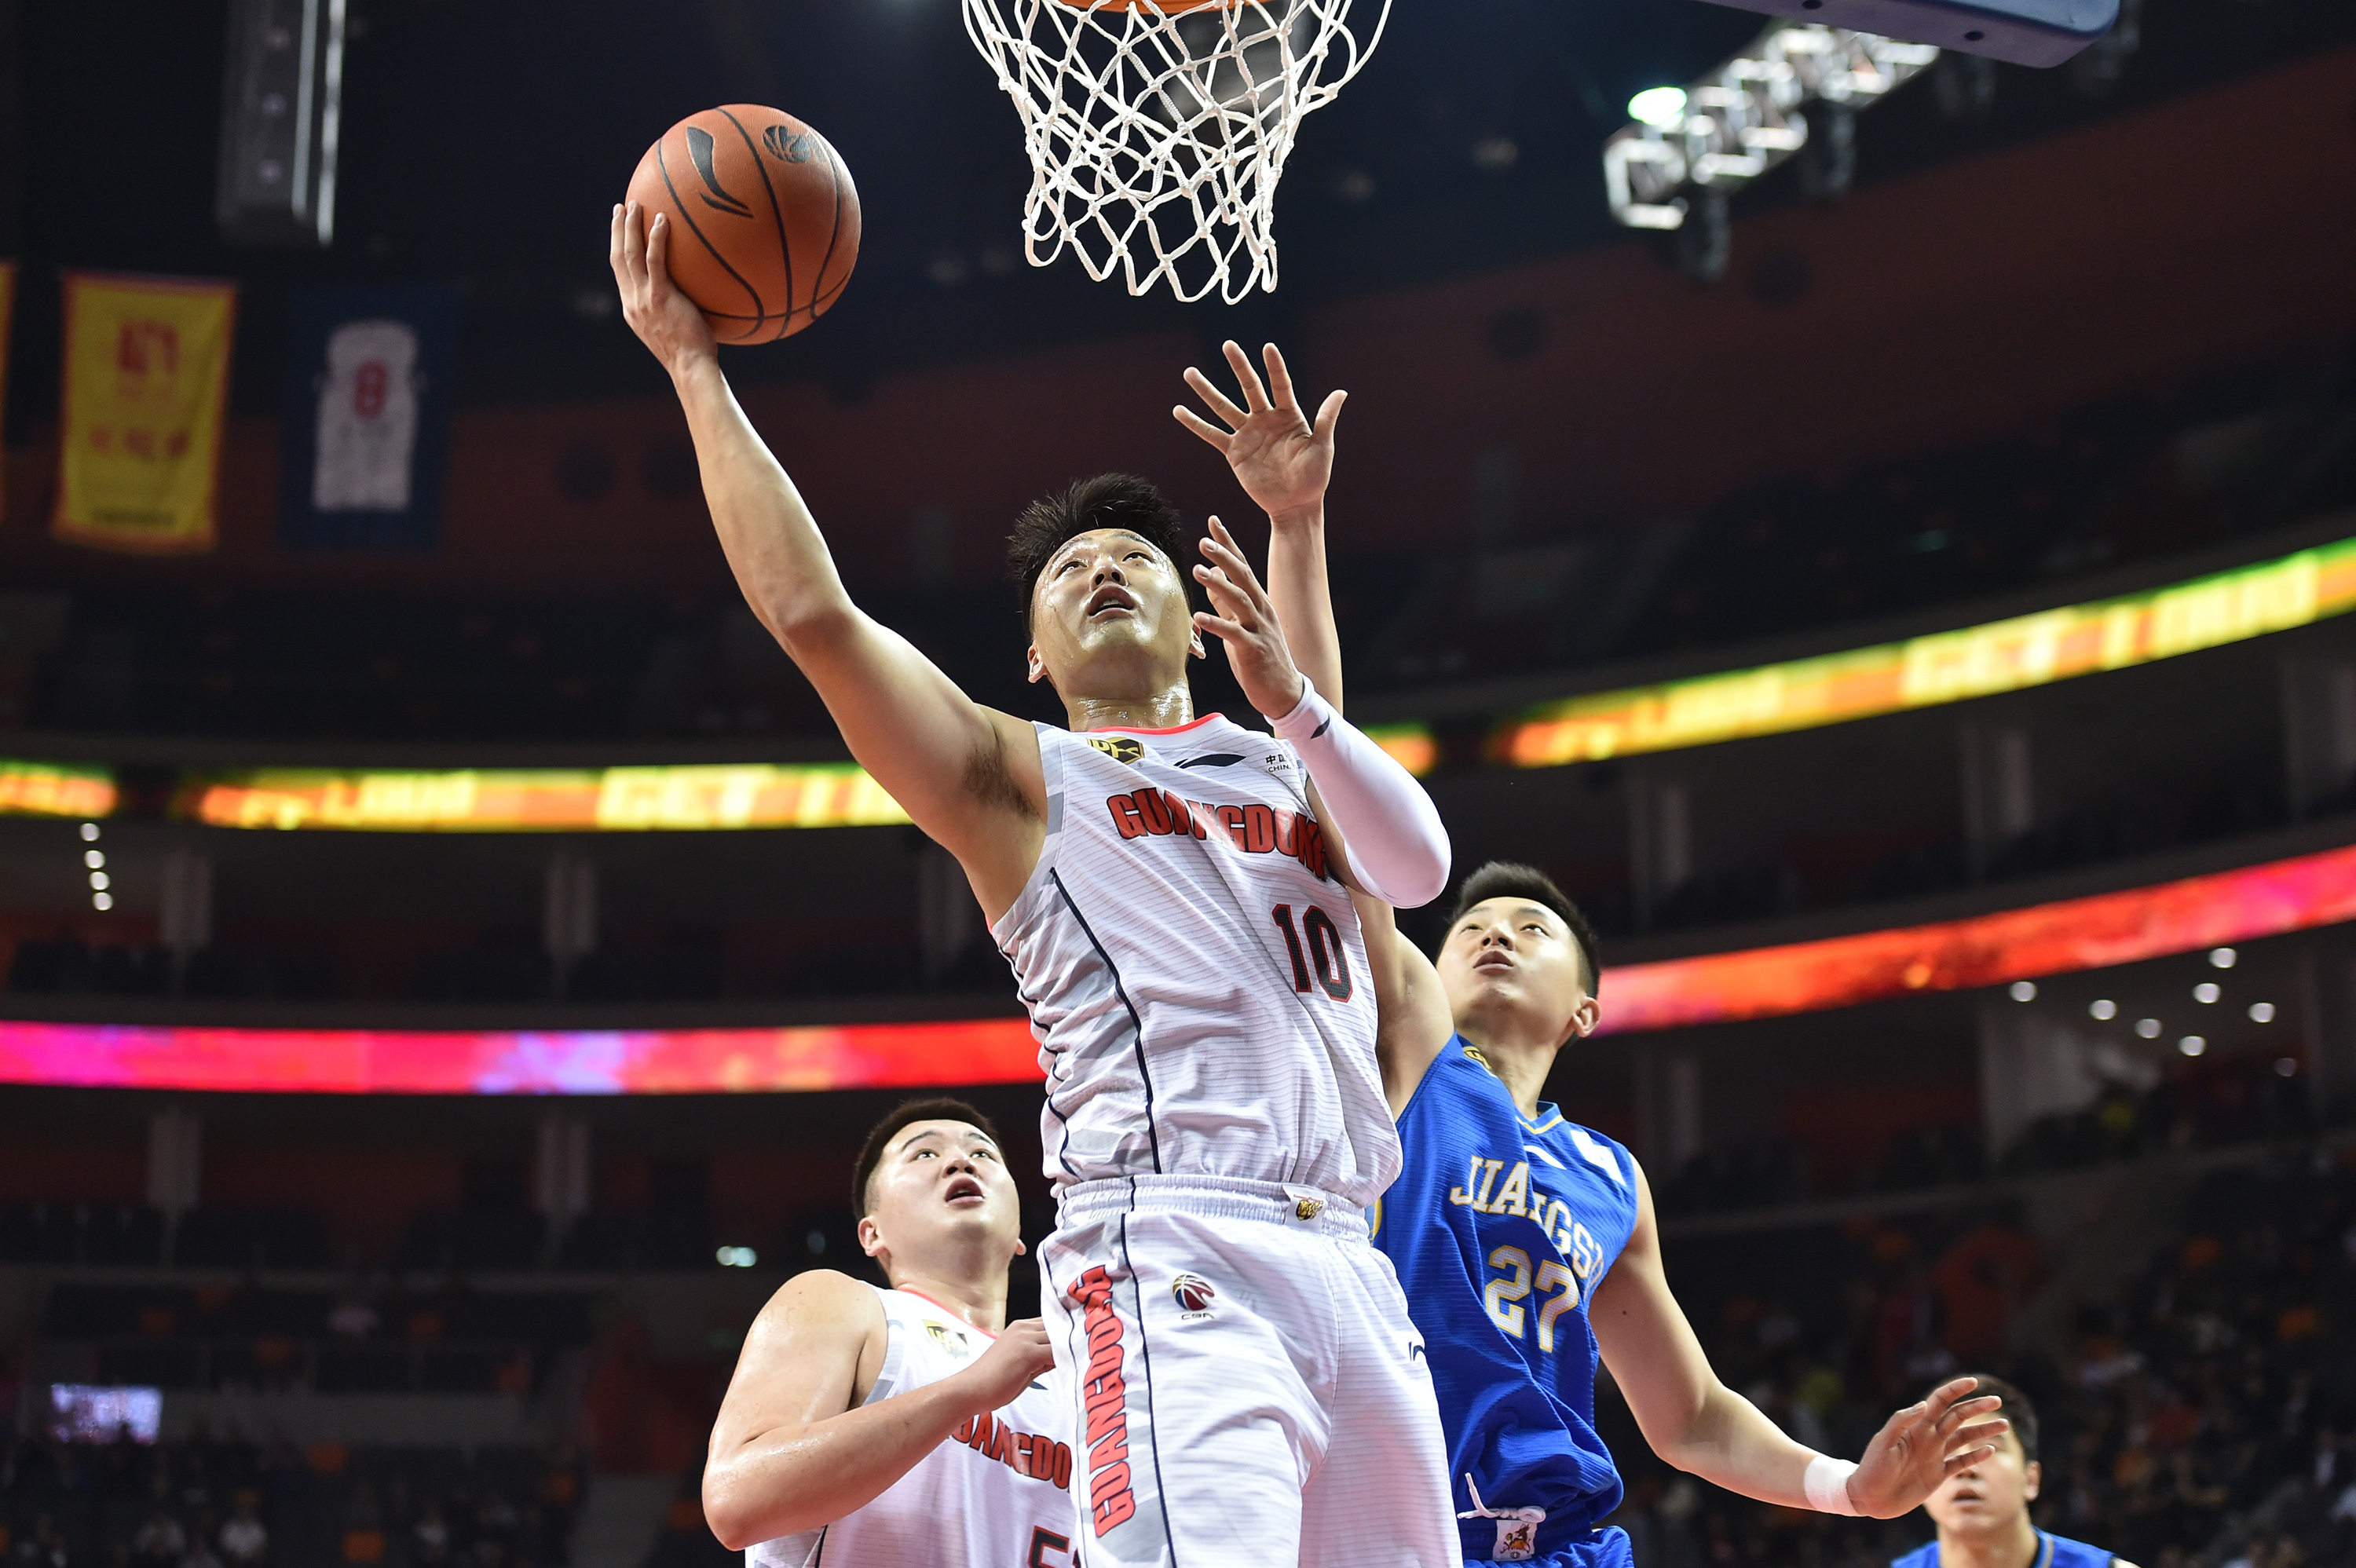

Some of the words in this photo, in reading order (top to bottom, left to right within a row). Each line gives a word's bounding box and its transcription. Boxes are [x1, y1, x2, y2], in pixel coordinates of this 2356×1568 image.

[1268, 764, 1292, 773] CHIN
[1271, 904, 1353, 1003] 10
[1486, 1245, 1579, 1352] 27
